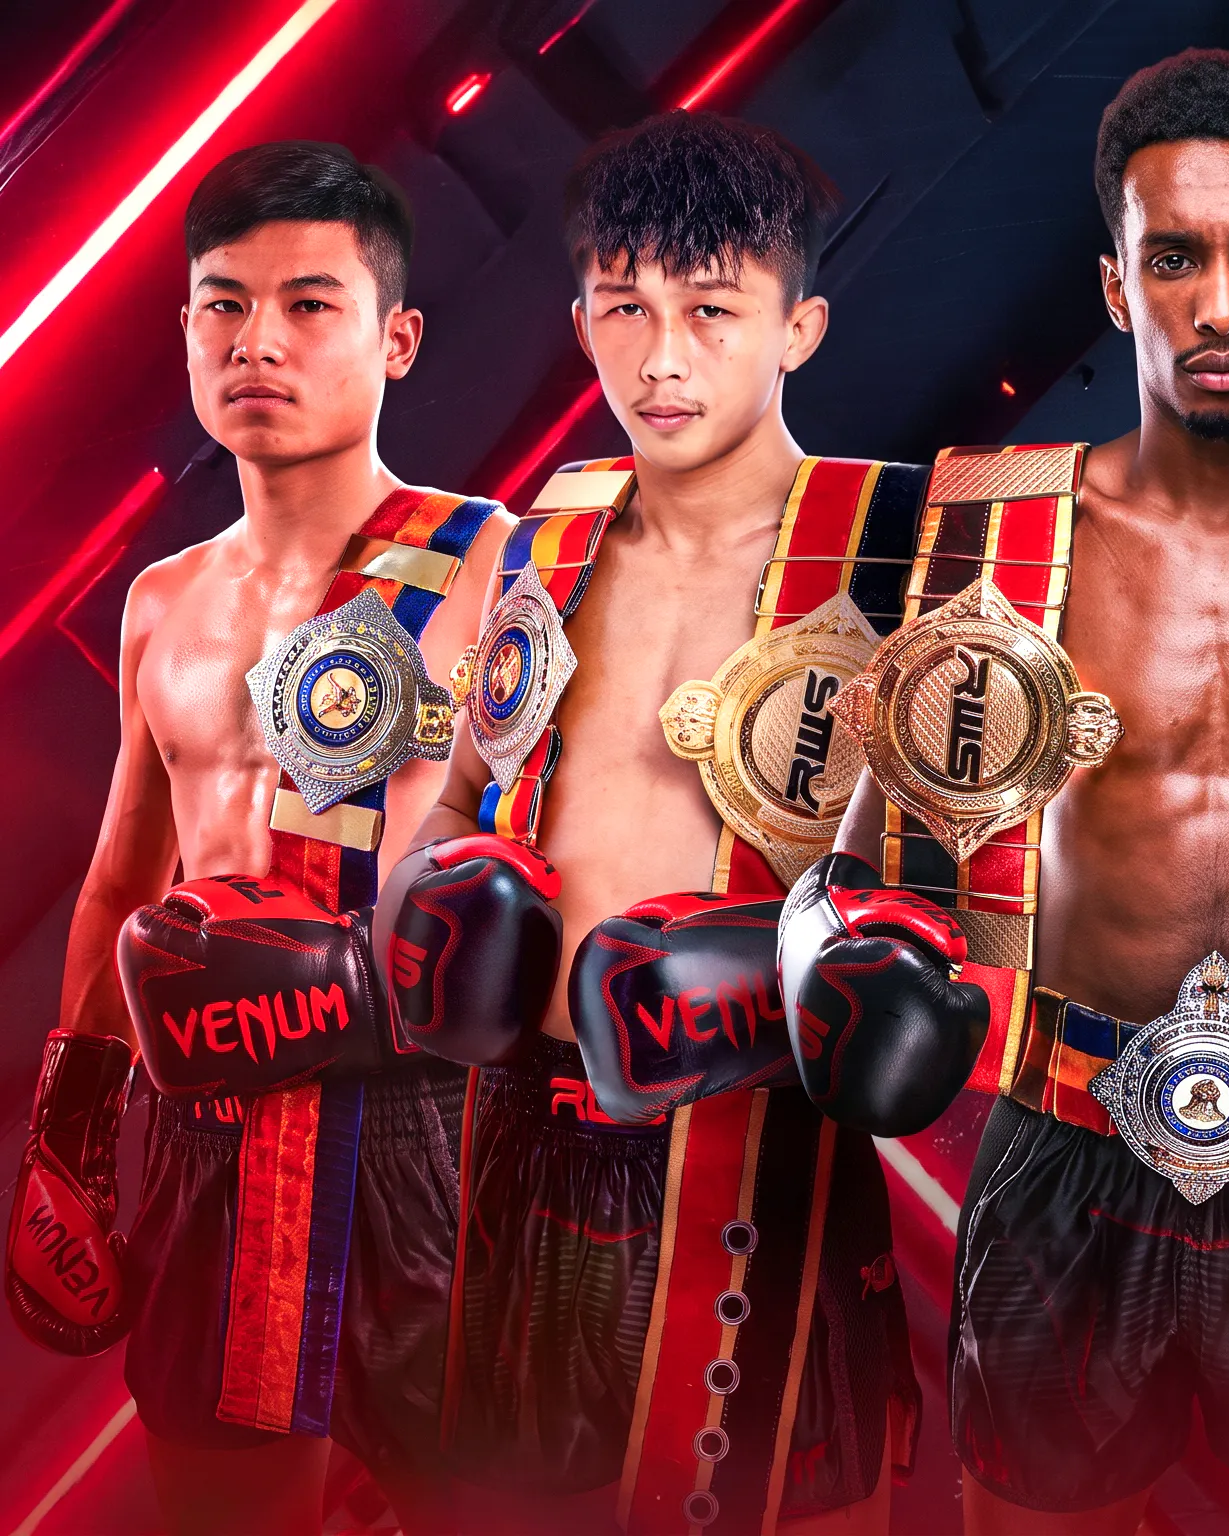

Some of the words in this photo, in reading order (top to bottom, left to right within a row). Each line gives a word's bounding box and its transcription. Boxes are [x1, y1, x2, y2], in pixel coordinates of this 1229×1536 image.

[784, 667, 840, 816] RWS
[947, 645, 992, 784] RWS
[162, 982, 350, 1065] VENUM
[637, 970, 787, 1051] VENU
[25, 1204, 111, 1318] VENUM
